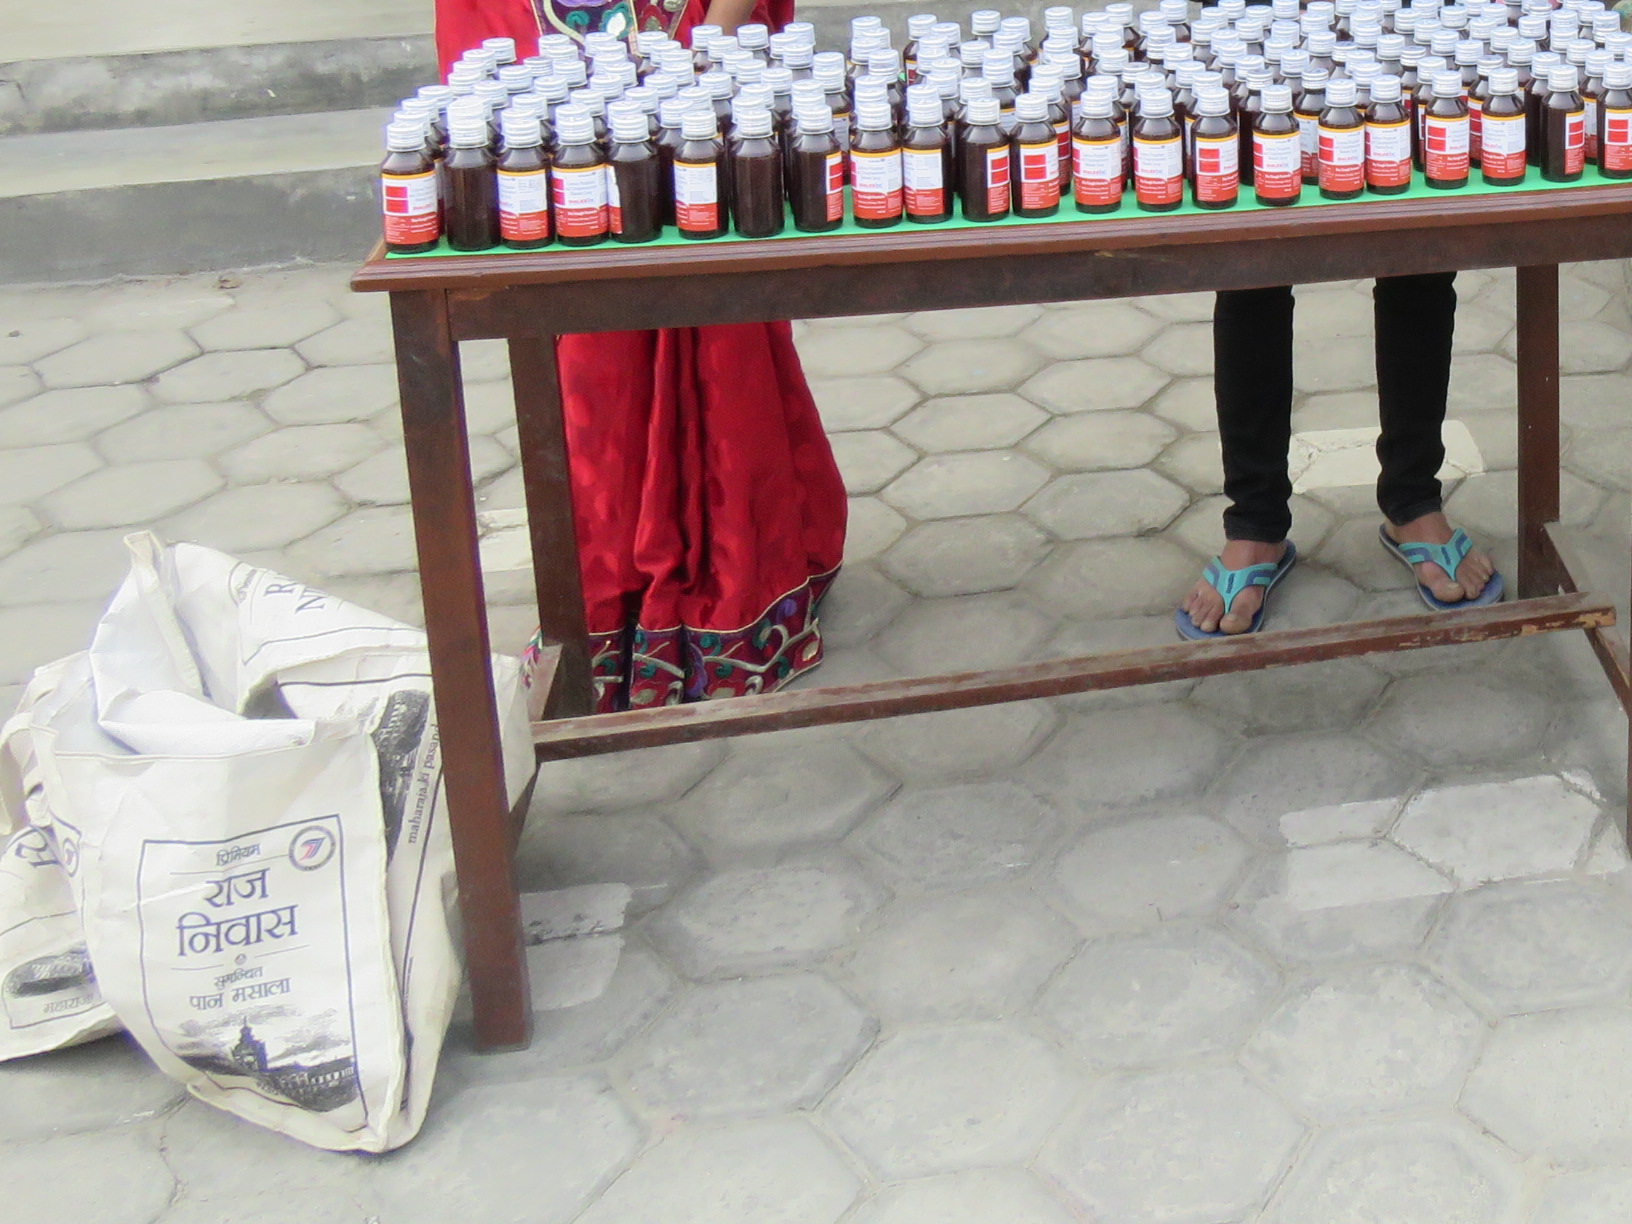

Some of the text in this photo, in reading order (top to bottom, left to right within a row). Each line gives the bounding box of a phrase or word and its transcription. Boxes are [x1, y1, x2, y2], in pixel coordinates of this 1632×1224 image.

[203, 867, 271, 910] राज
[175, 902, 300, 959] निवास
[188, 975, 293, 1013] पान मसाला
